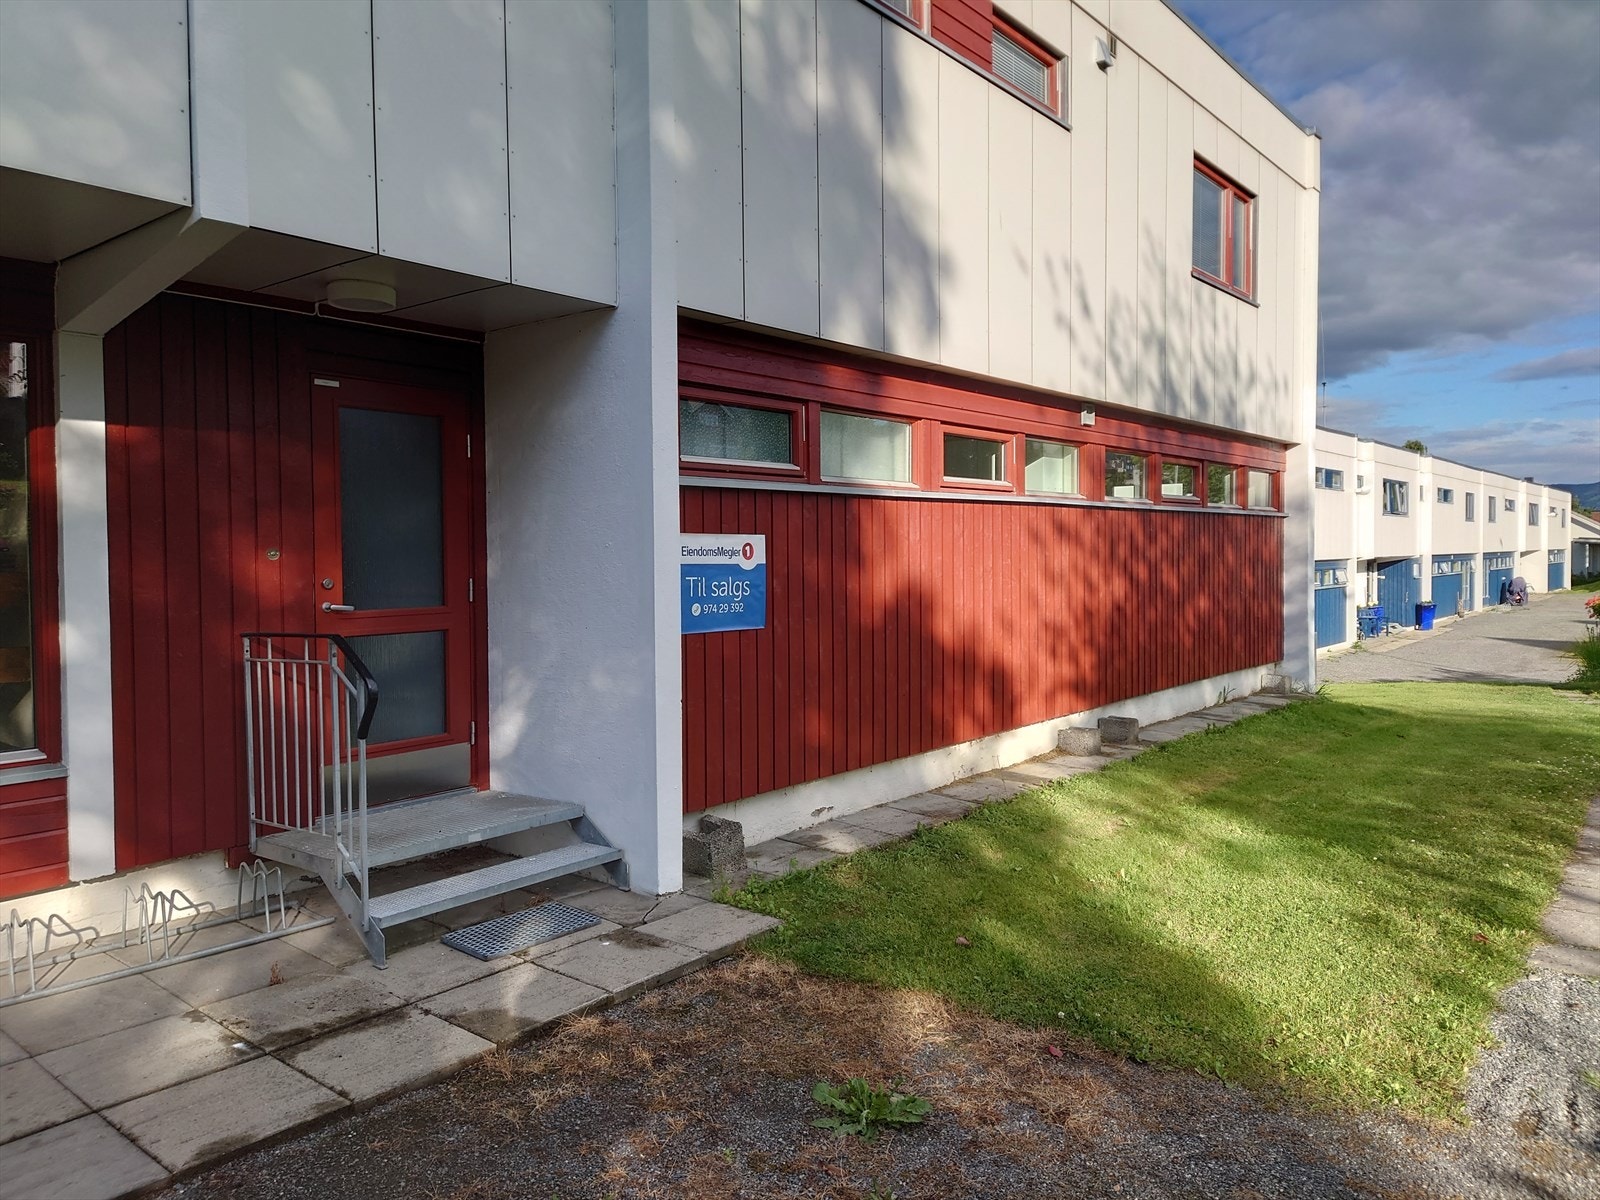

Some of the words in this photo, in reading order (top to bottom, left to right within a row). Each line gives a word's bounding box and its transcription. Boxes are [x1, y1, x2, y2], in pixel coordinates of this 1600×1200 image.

[681, 546, 741, 560] EiendomsMegler
[685, 576, 707, 597] Til
[711, 576, 751, 601] salgs
[703, 604, 717, 614] 974
[719, 603, 729, 613] 29
[730, 602, 744, 613] 392
